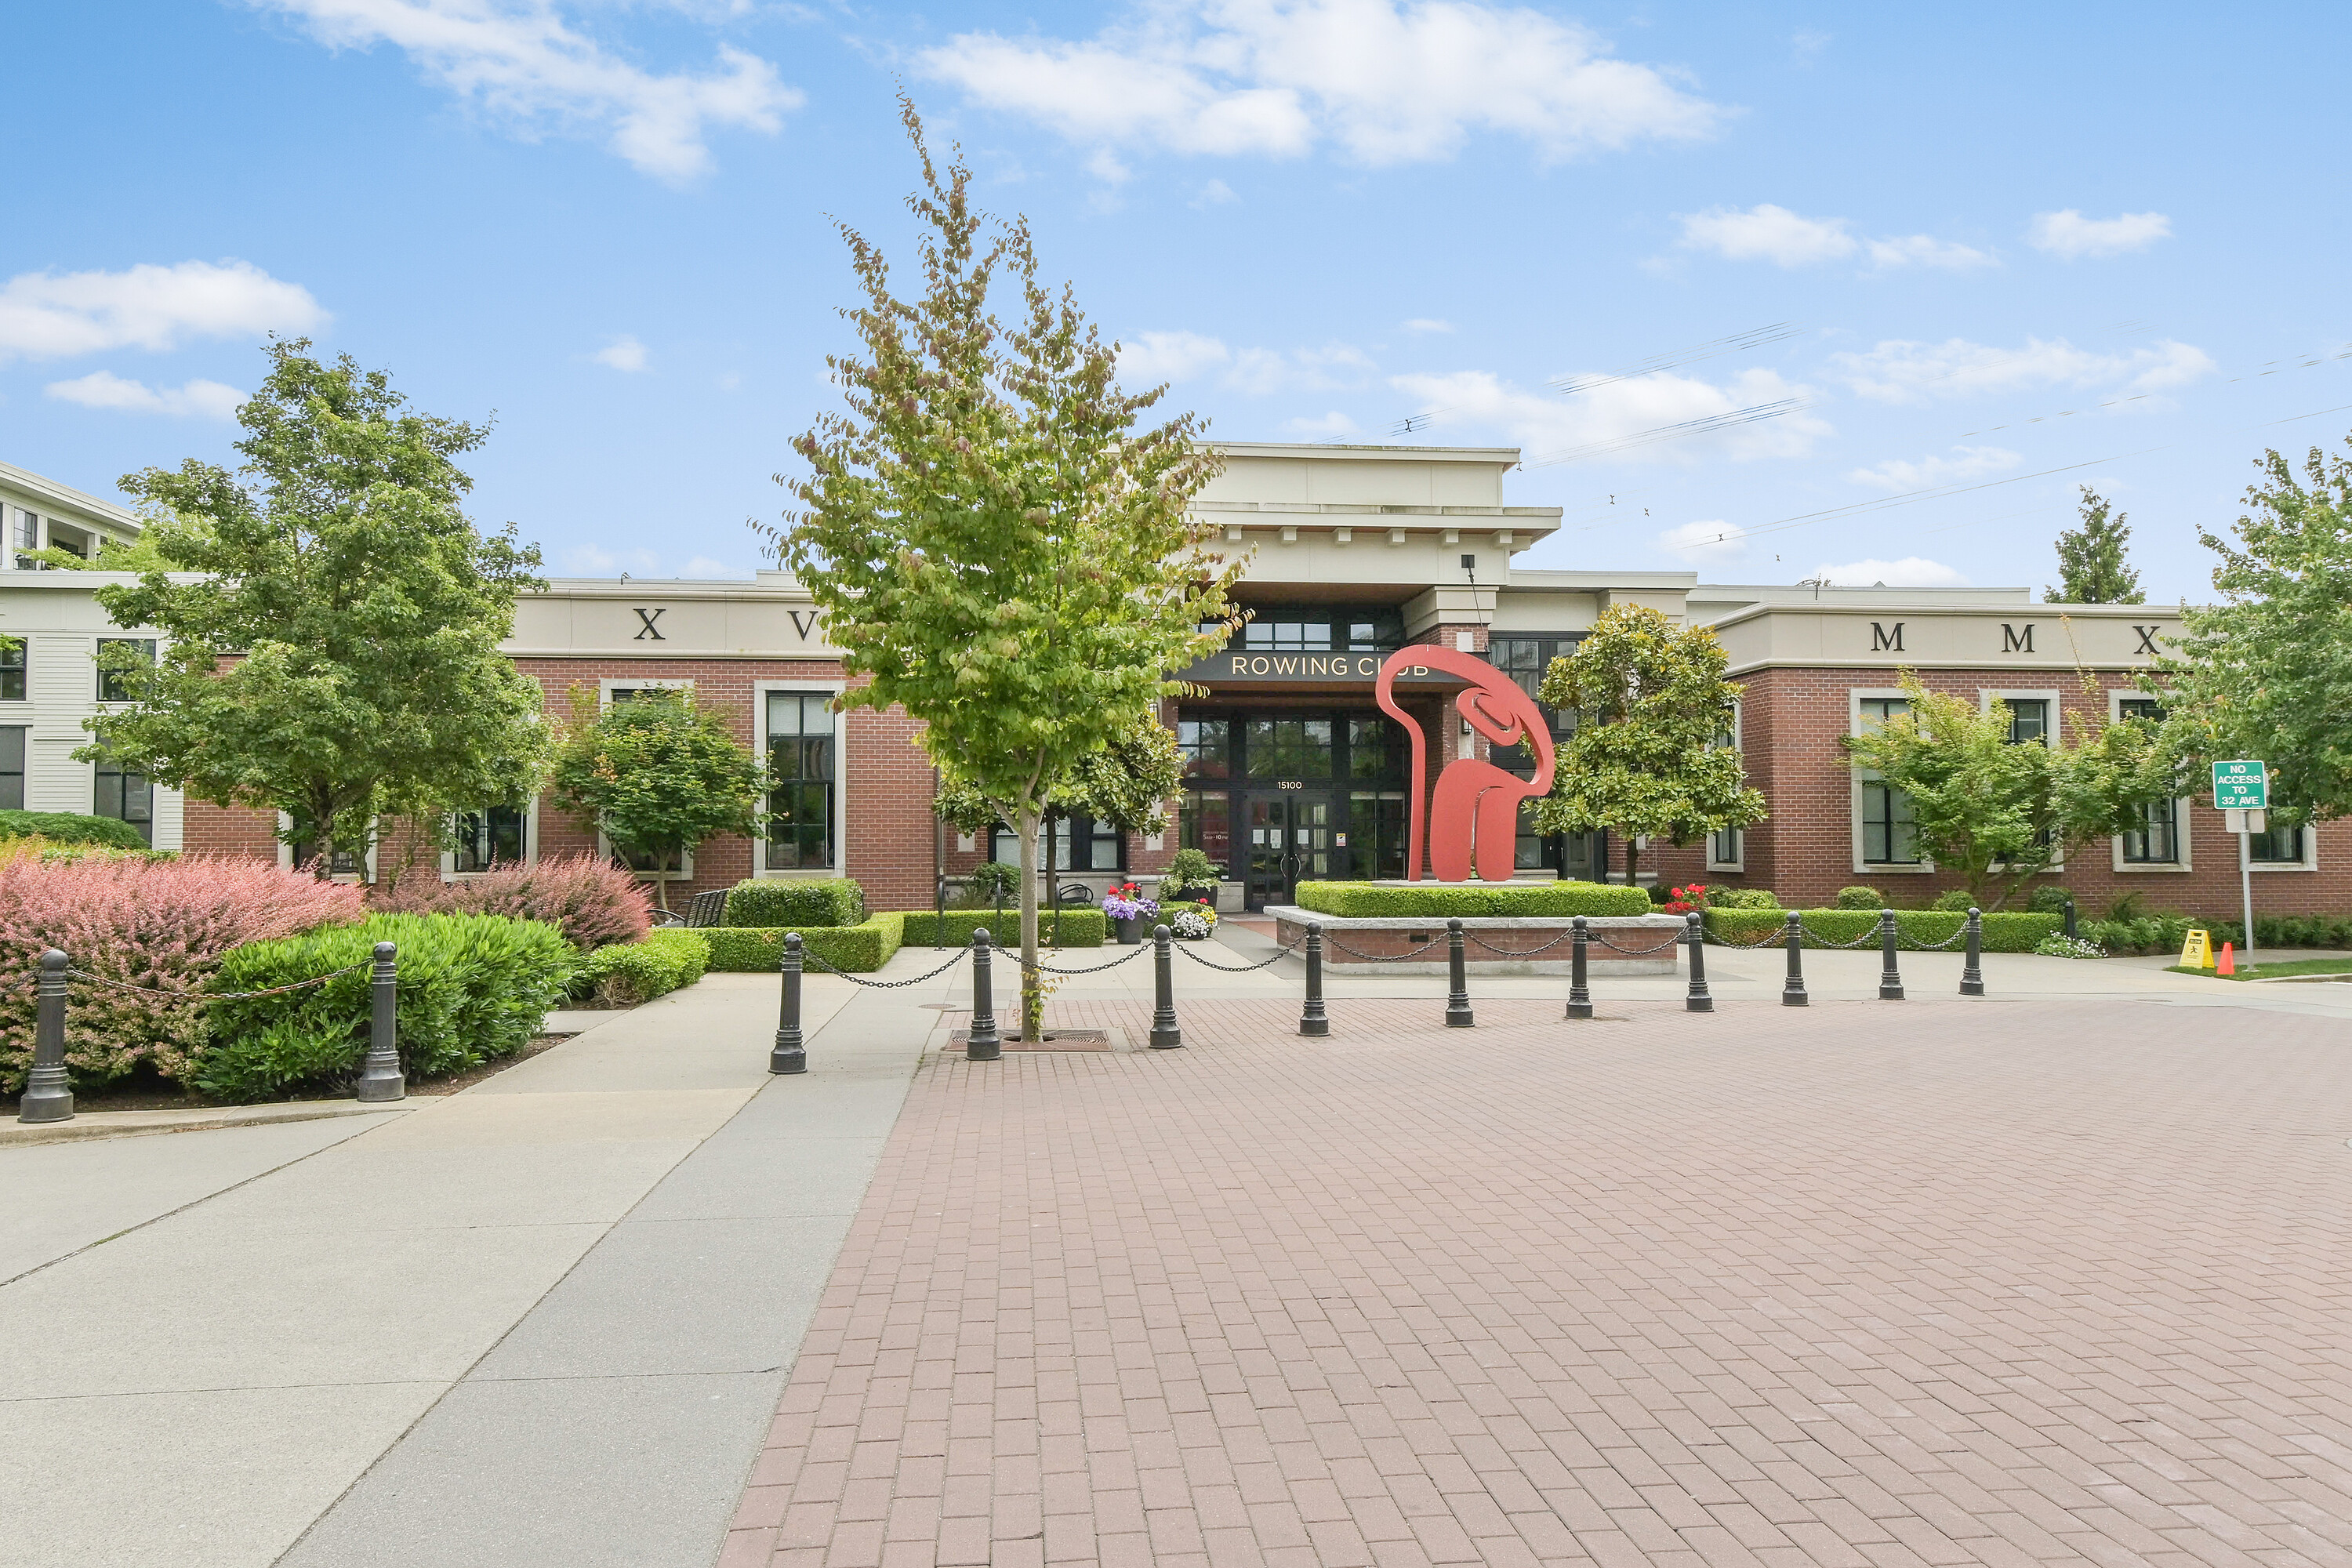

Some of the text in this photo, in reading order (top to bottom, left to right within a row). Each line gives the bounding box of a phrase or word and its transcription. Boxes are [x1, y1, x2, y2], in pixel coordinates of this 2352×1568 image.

[633, 608, 819, 641] X V
[1870, 622, 2161, 655] M M X
[1232, 656, 1348, 676] ROWING
[2230, 764, 2246, 774] NO
[1277, 781, 1302, 789] 15100
[2217, 775, 2262, 785] ACCESS
[2231, 786, 2247, 794] TO
[2221, 796, 2259, 805] 32 AVE
